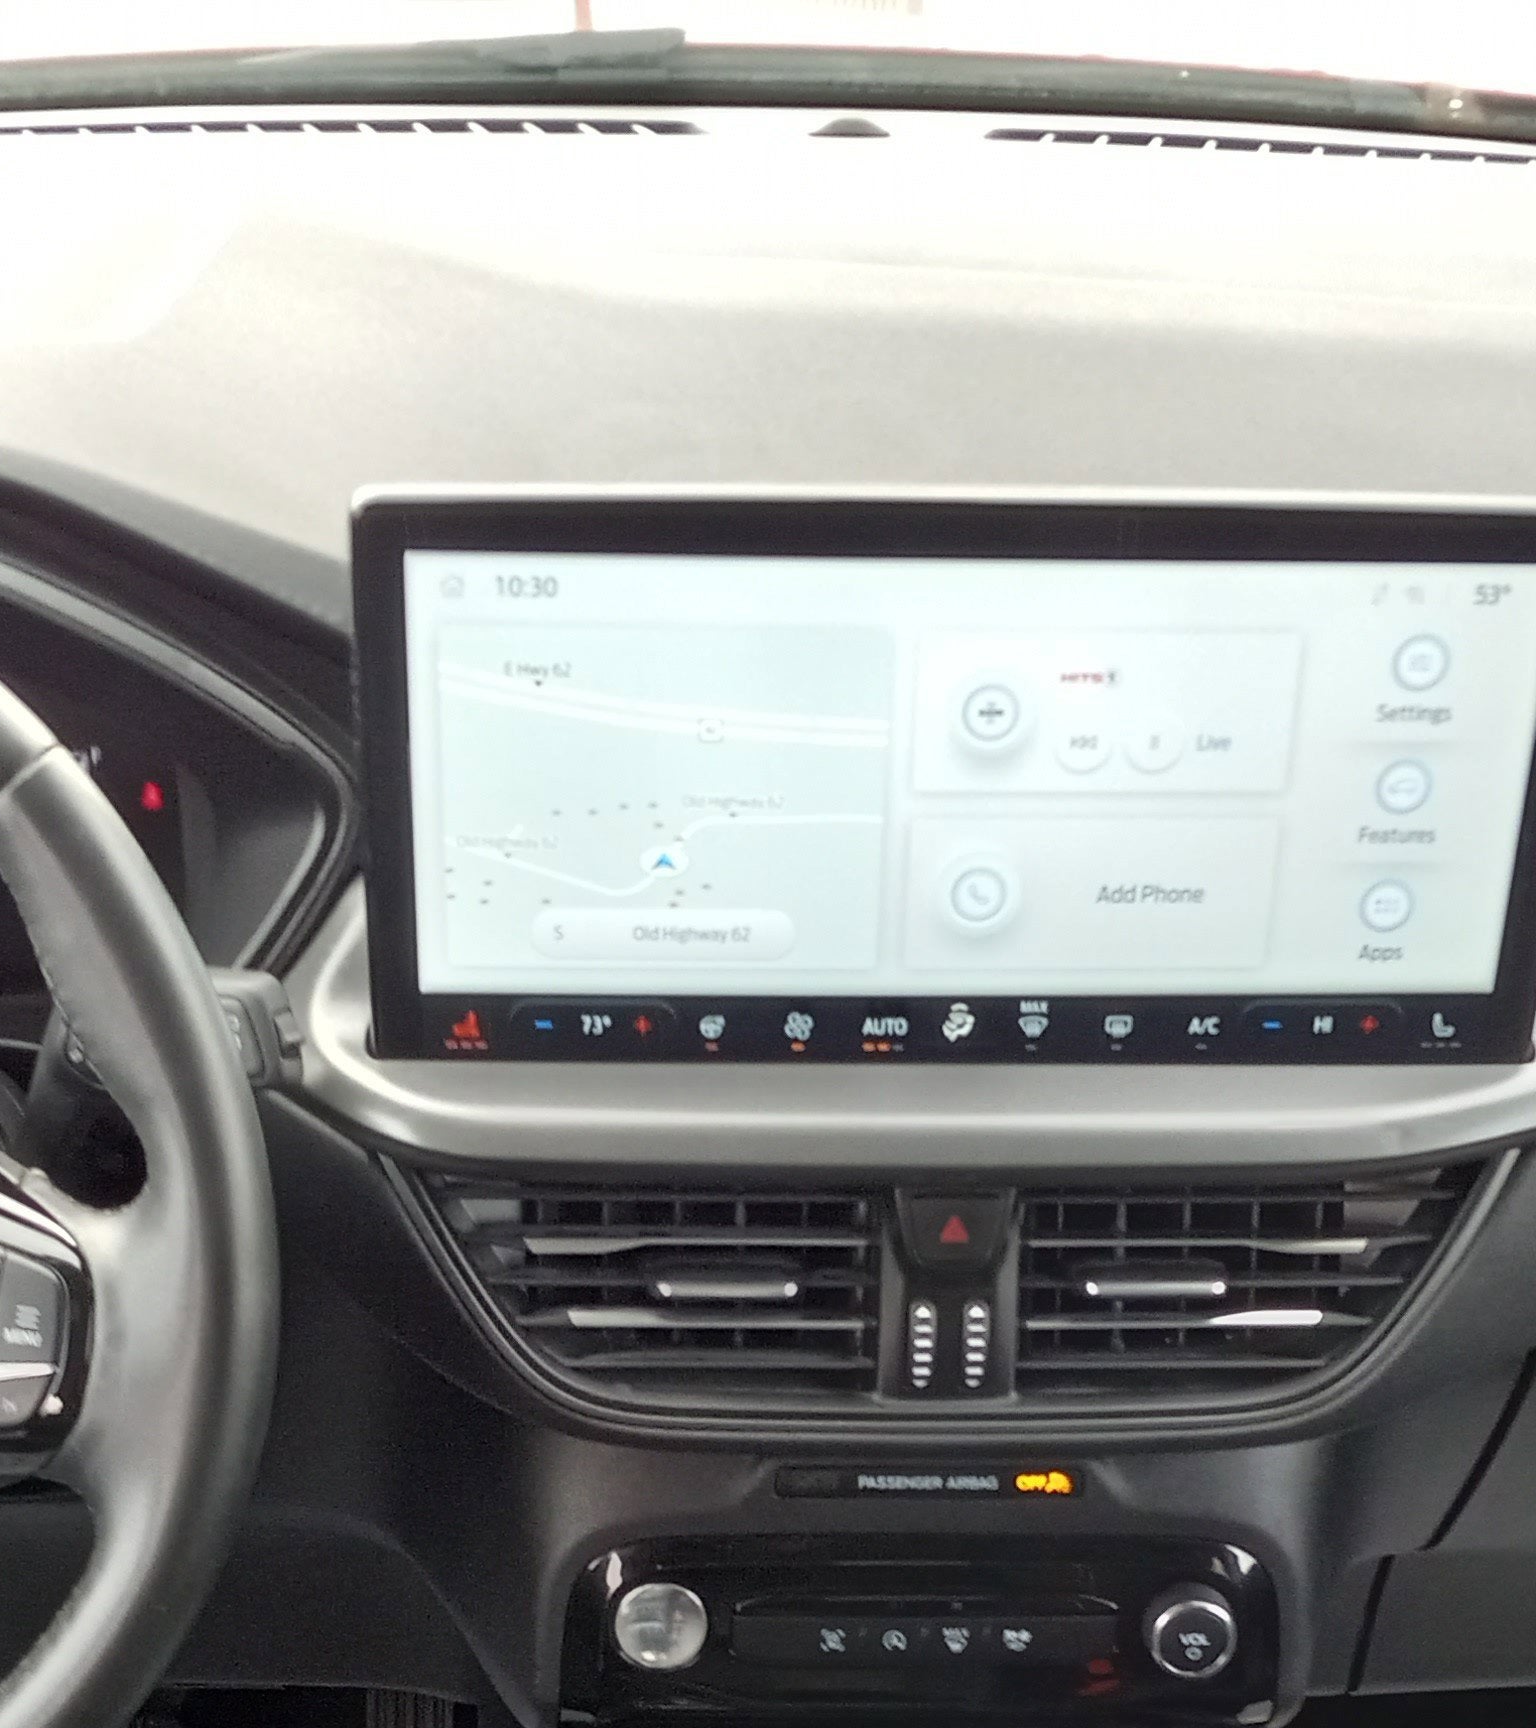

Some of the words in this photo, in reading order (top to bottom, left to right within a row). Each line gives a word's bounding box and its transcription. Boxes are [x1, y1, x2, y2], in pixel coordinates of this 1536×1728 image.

[495, 575, 560, 599] 10:30
[552, 661, 573, 679] 62
[1376, 703, 1454, 726] Settings
[1196, 734, 1233, 752] Live
[1358, 825, 1437, 845] Features
[1096, 884, 1138, 905] Add
[1140, 883, 1206, 906] Phone
[632, 925, 660, 942] Old
[662, 926, 729, 945] Highway
[730, 925, 754, 944] 62
[1358, 944, 1405, 964] Apps
[580, 1014, 614, 1036] 73°
[861, 1017, 910, 1037] AUTO
[1187, 1016, 1222, 1036] A/C
[857, 1474, 944, 1492] PASSENGER
[945, 1474, 1000, 1492] AIRBAG
[1178, 1632, 1212, 1647] VOL
